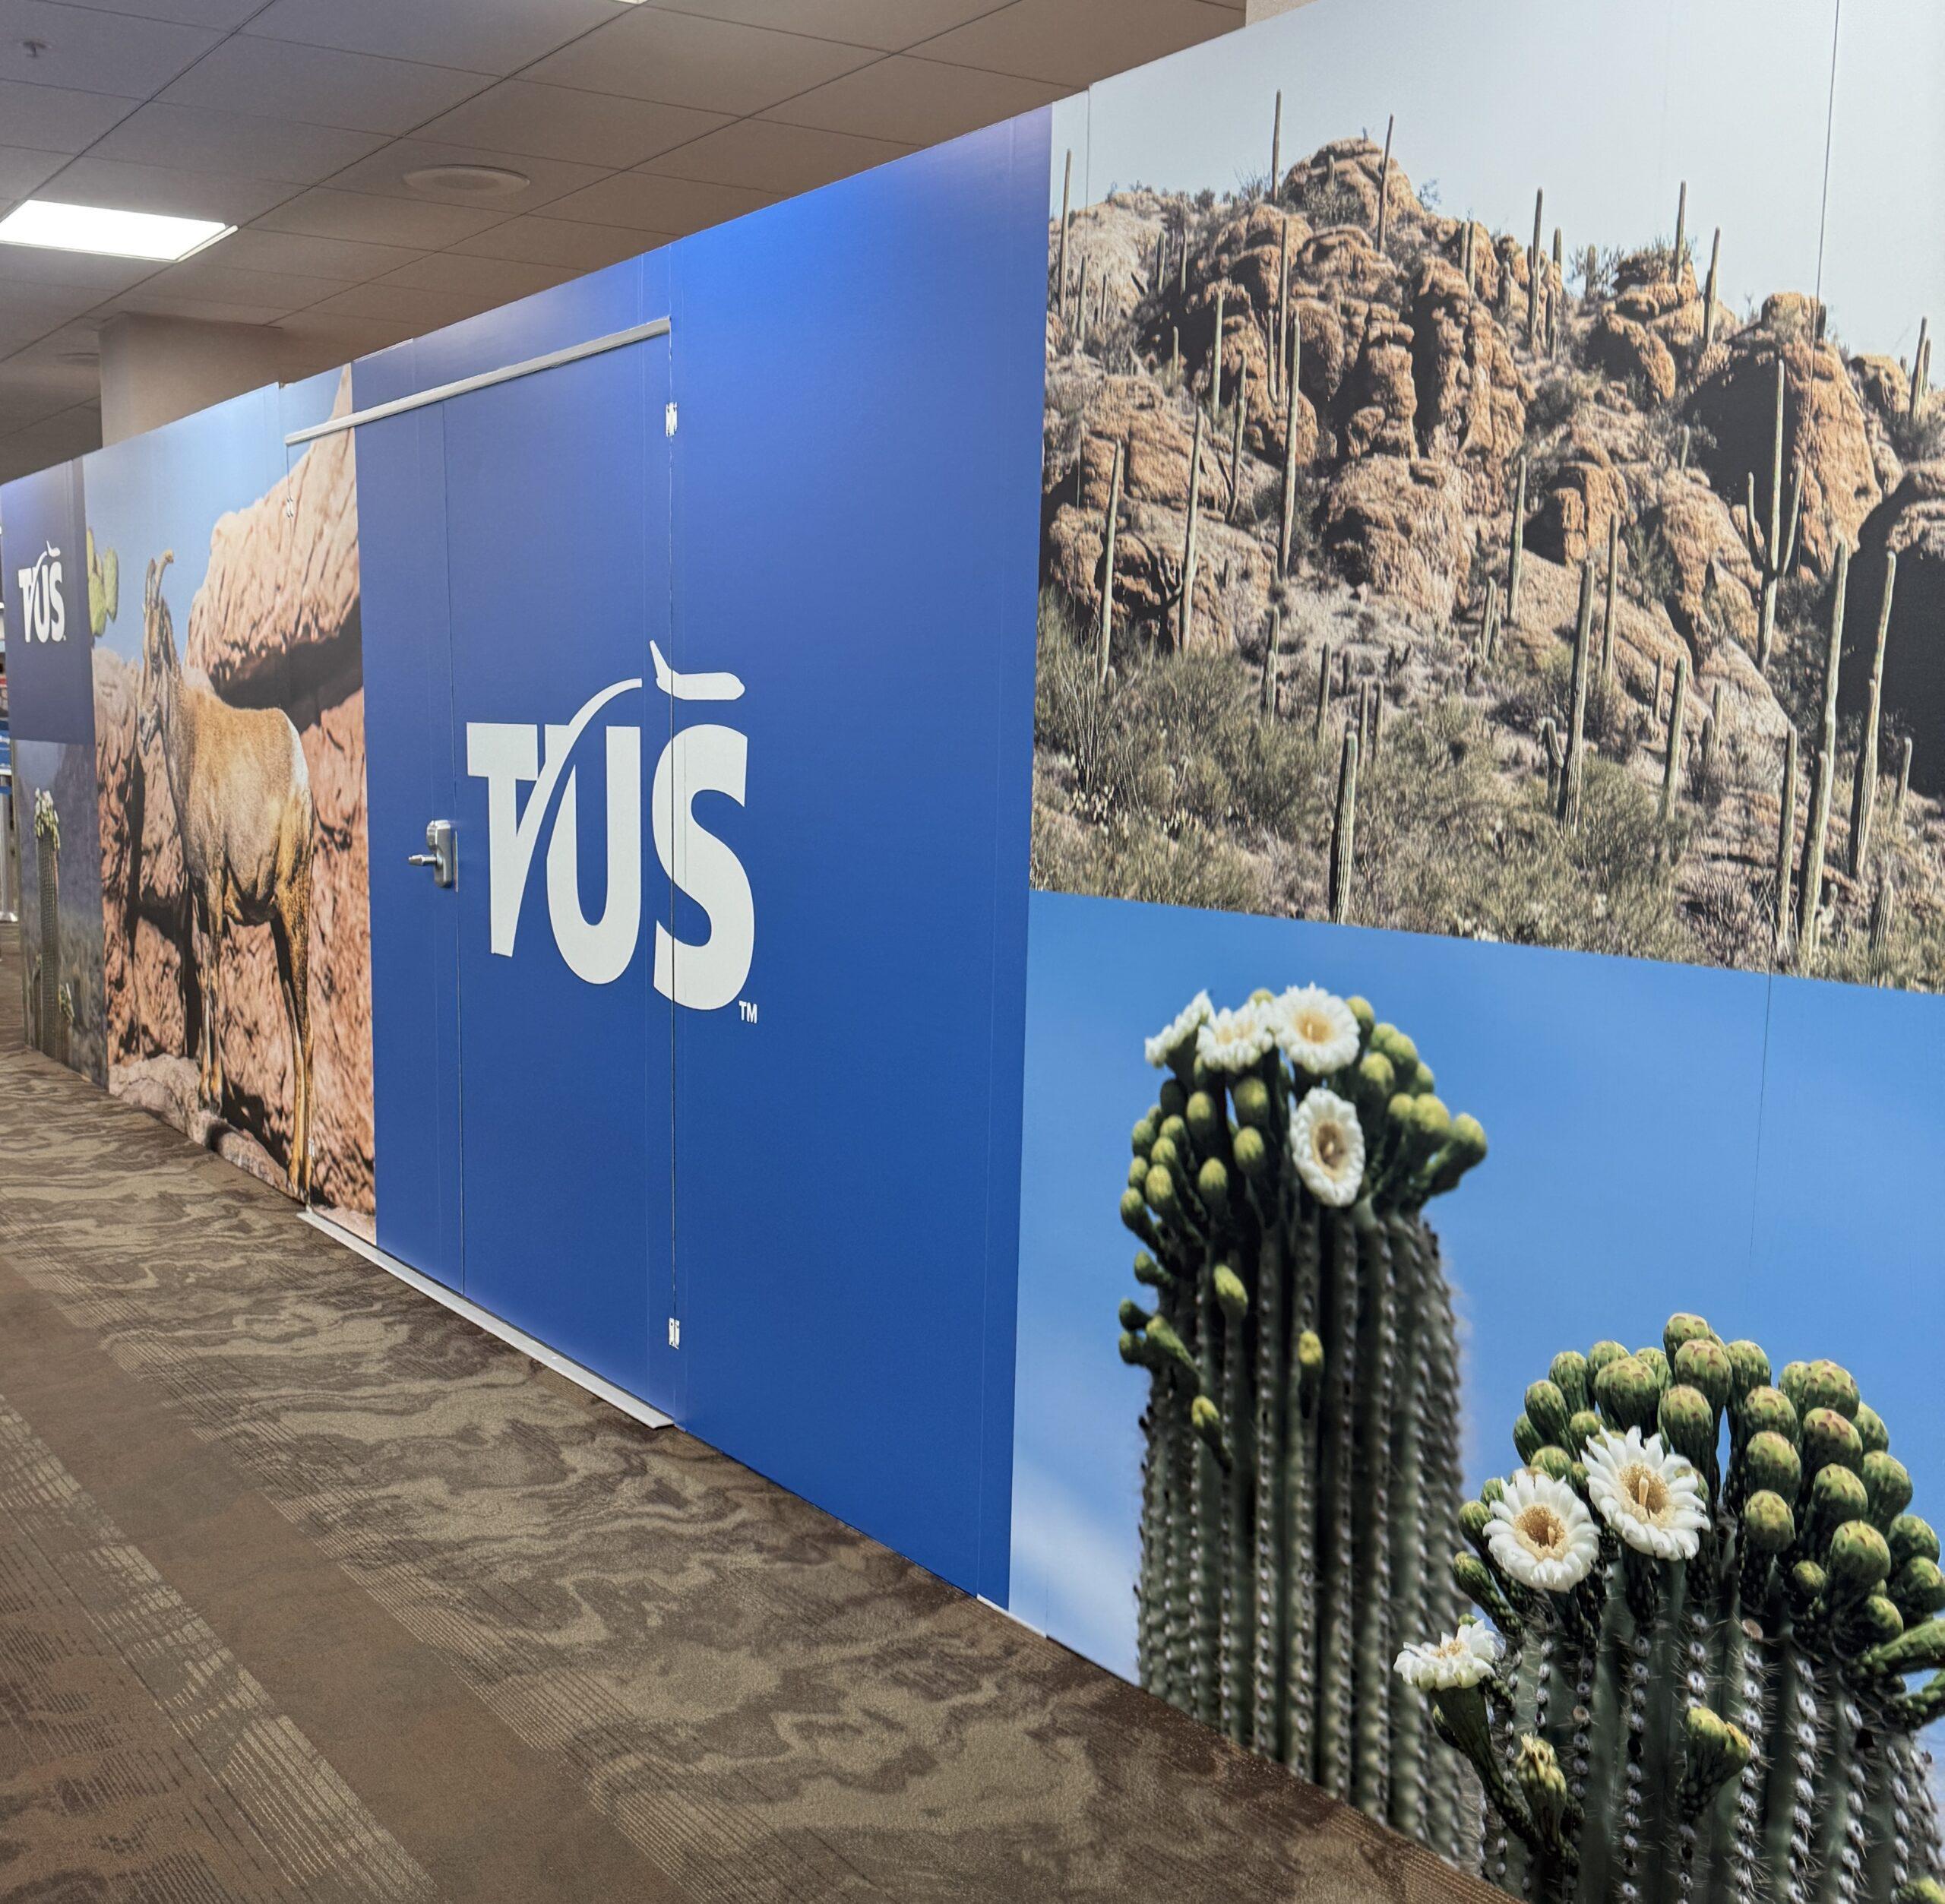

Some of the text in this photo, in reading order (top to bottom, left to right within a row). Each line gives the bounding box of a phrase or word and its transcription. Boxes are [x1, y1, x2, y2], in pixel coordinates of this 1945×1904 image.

[18, 550, 65, 643] TUS
[466, 678, 754, 1011] TUS
[738, 1000, 757, 1023] TM
